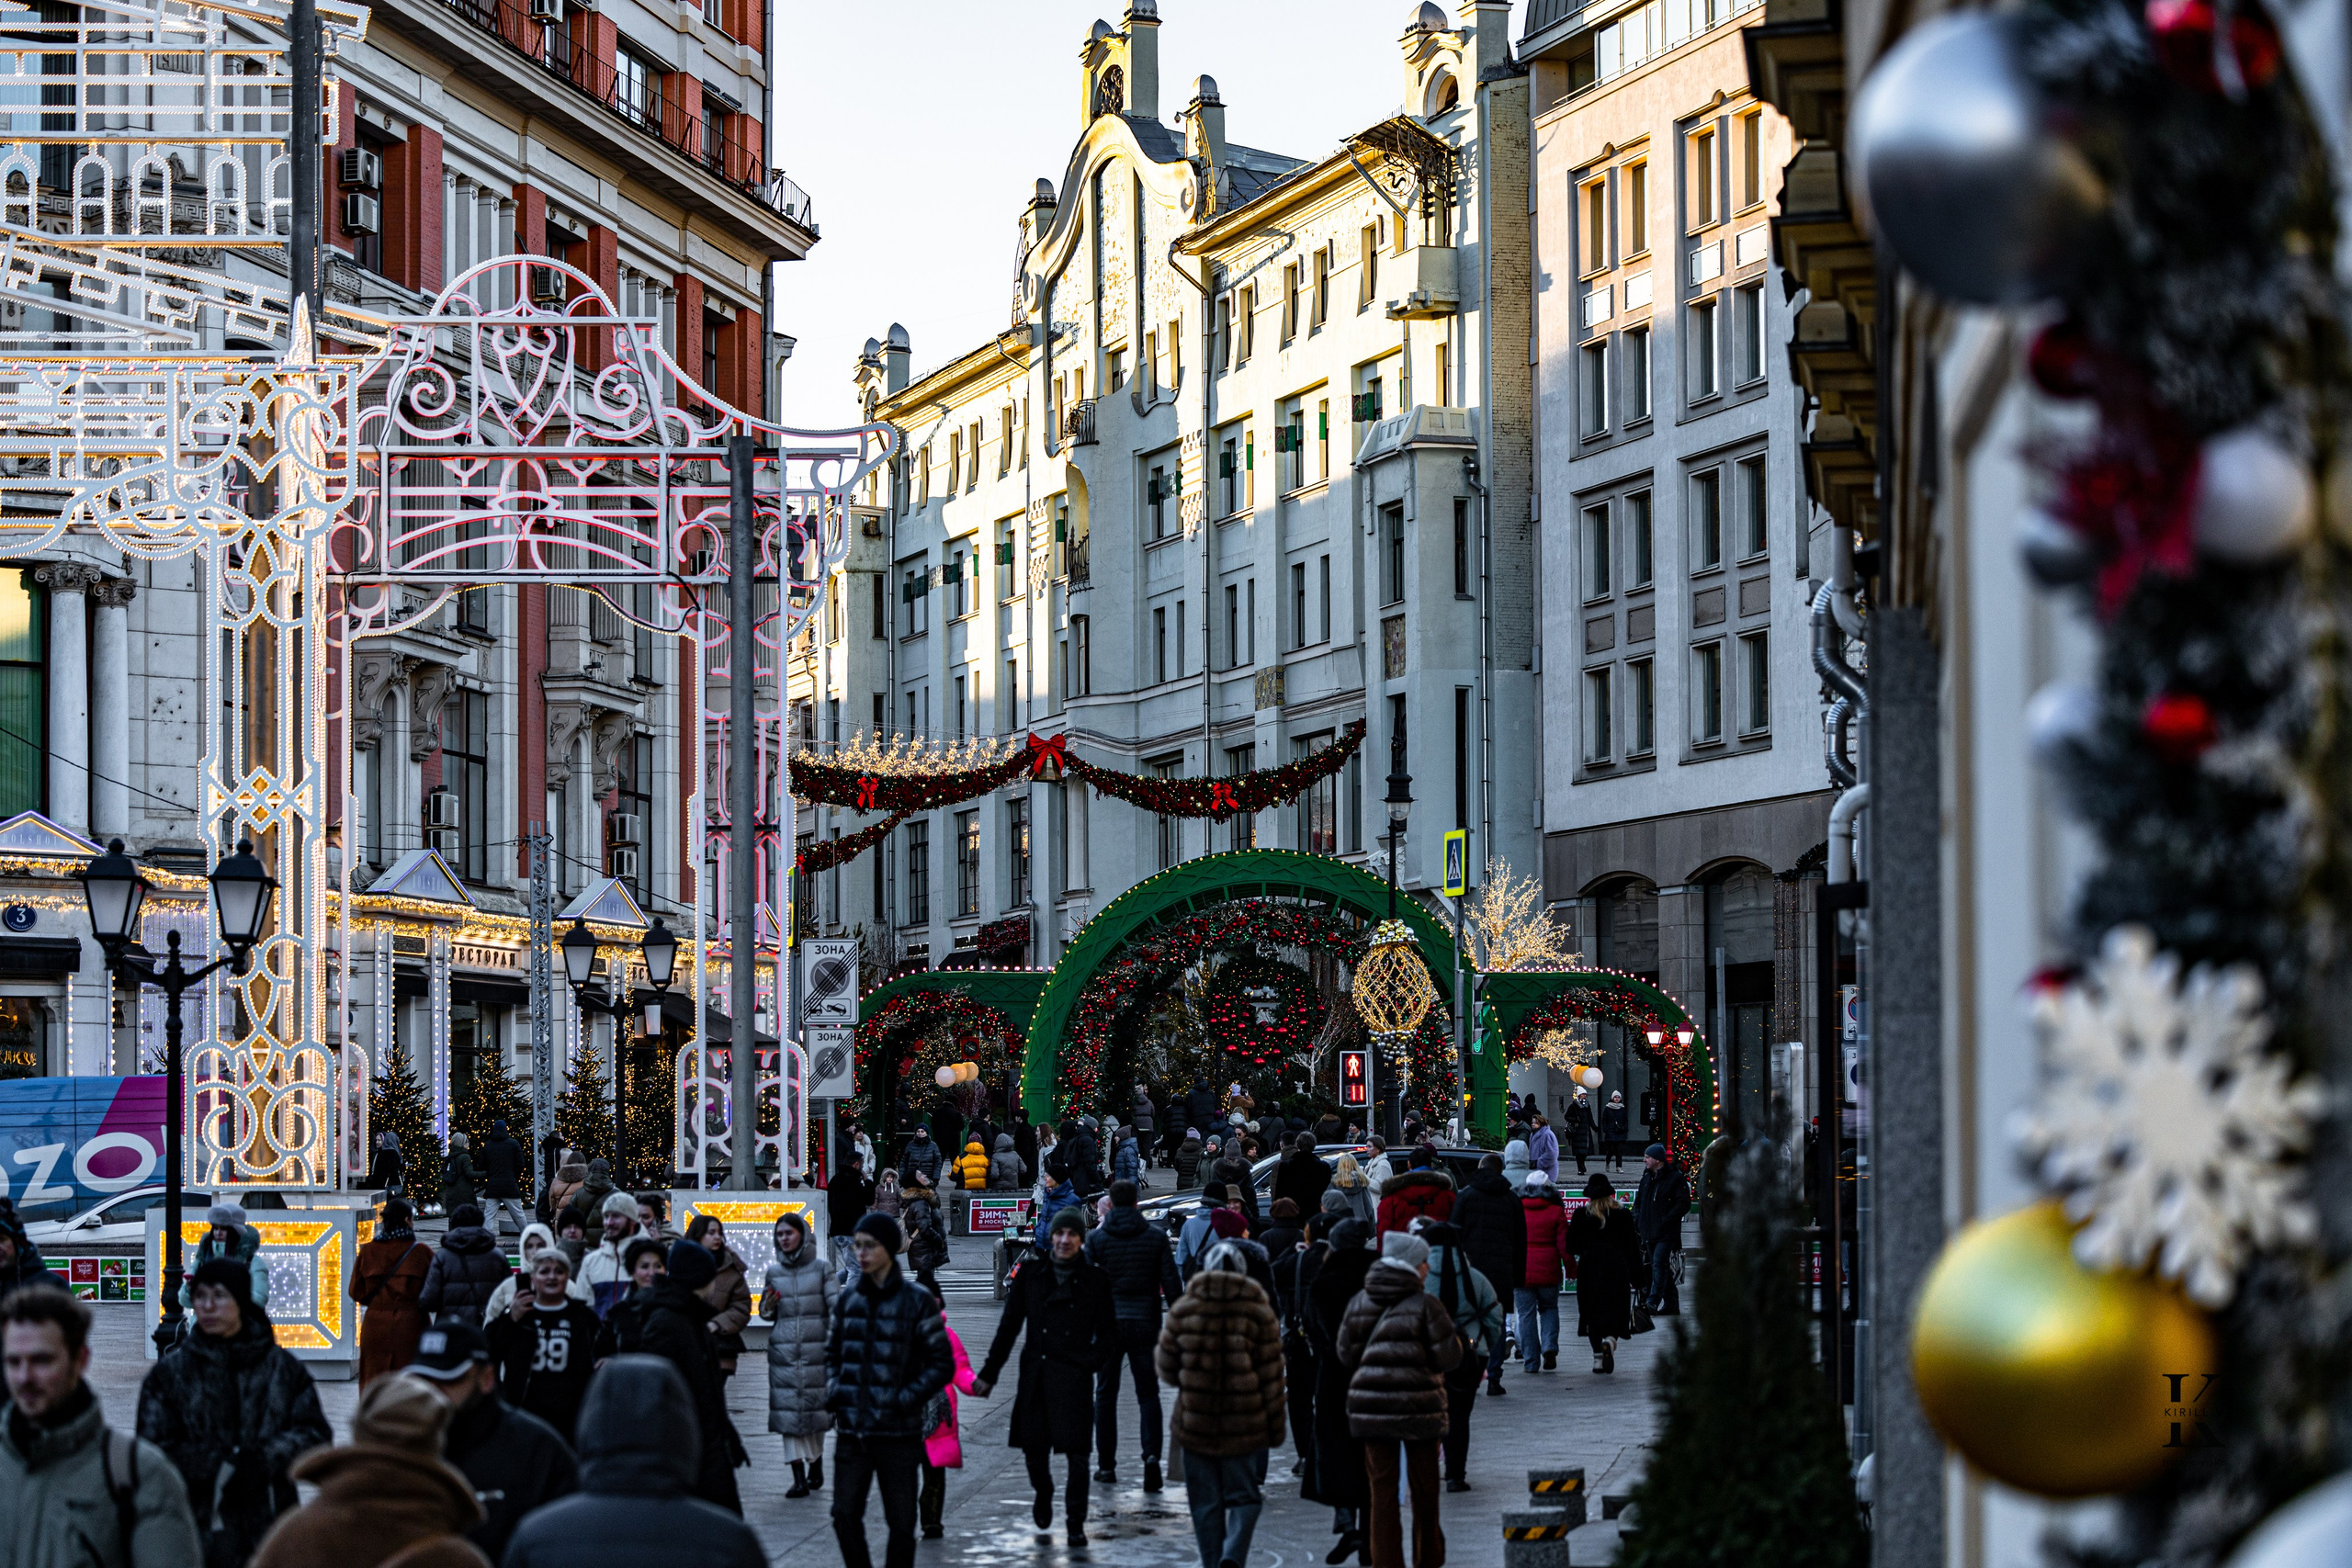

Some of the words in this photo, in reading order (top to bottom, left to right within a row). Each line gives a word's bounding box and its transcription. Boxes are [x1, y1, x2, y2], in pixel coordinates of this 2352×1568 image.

[16, 908, 27, 923] 3
[814, 944, 846, 955] ЗОНА
[817, 1032, 843, 1042] ЗОНА
[1351, 1084, 1364, 1101] 11
[978, 1211, 1007, 1219] ЗИМ
